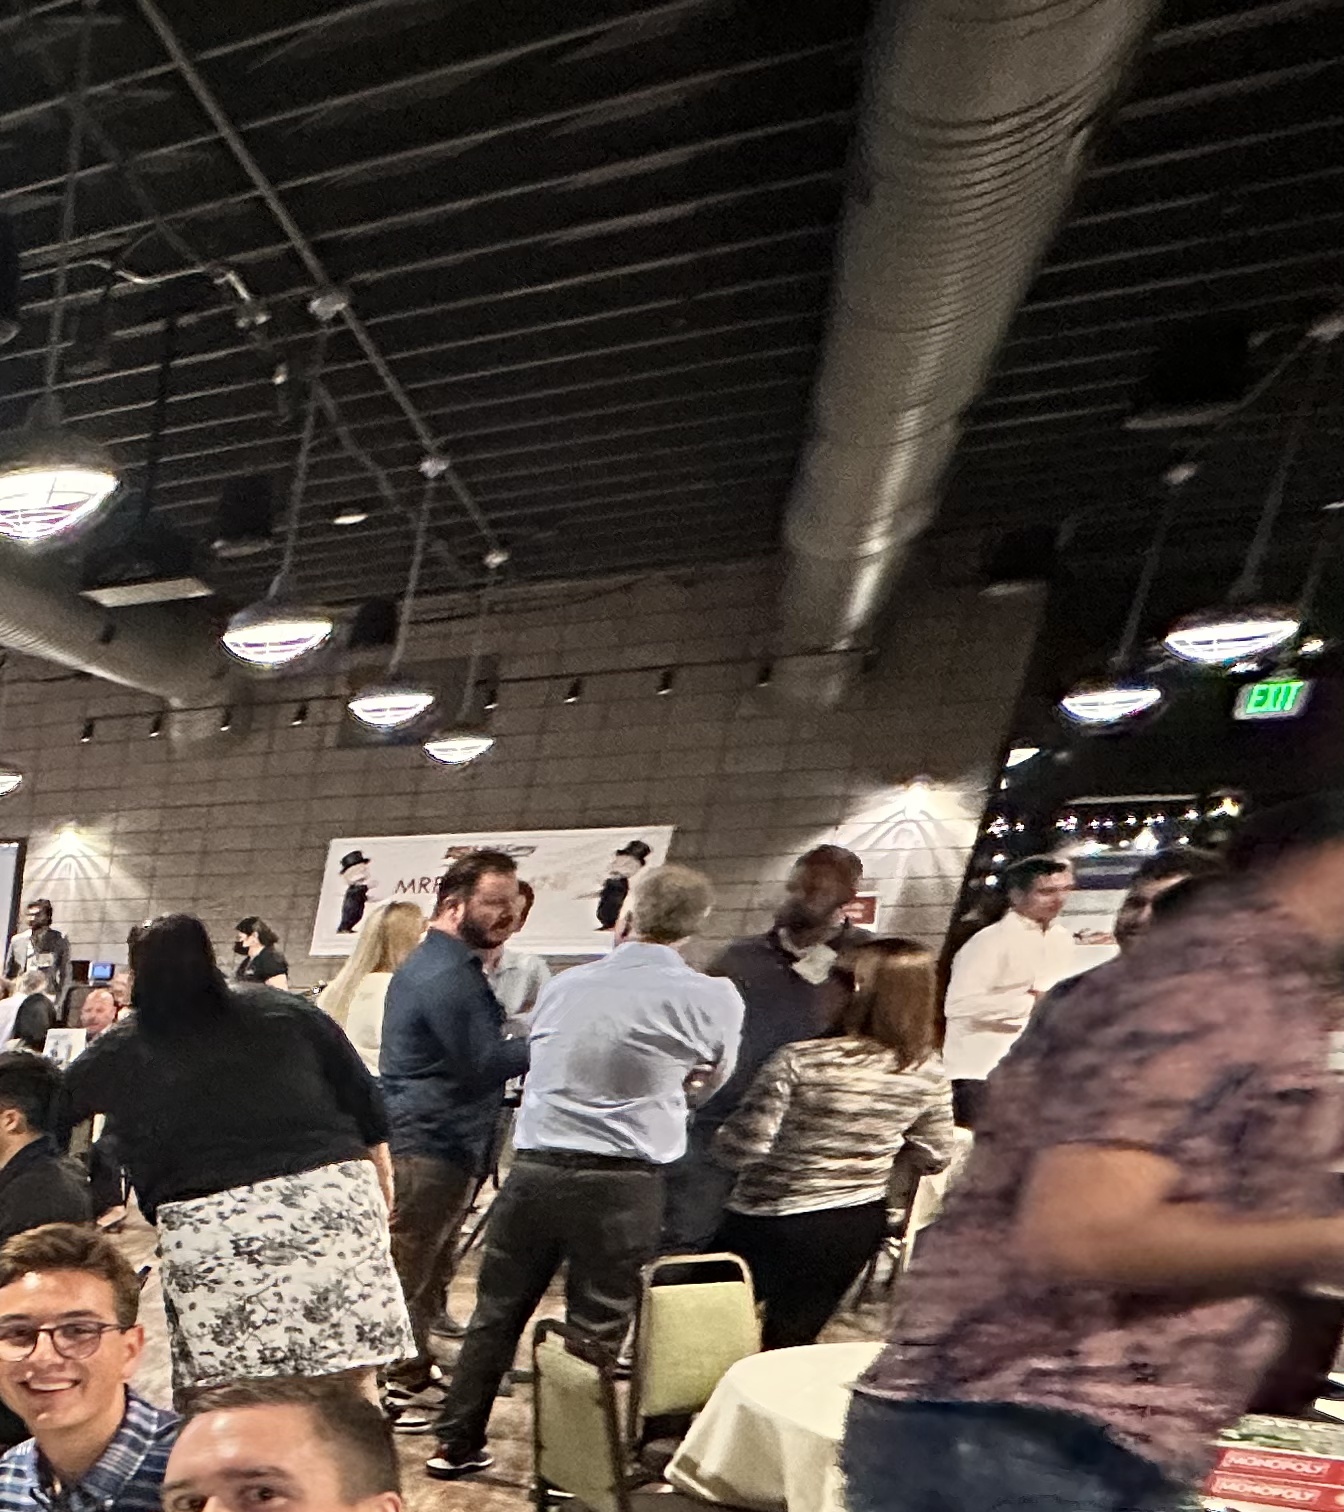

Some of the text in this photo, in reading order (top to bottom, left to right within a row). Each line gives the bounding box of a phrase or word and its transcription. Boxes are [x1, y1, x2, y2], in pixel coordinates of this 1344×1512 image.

[1247, 682, 1304, 713] EXIT
[1229, 1455, 1324, 1475] MONOPOLY
[1219, 1480, 1316, 1501] MONOPOLY
